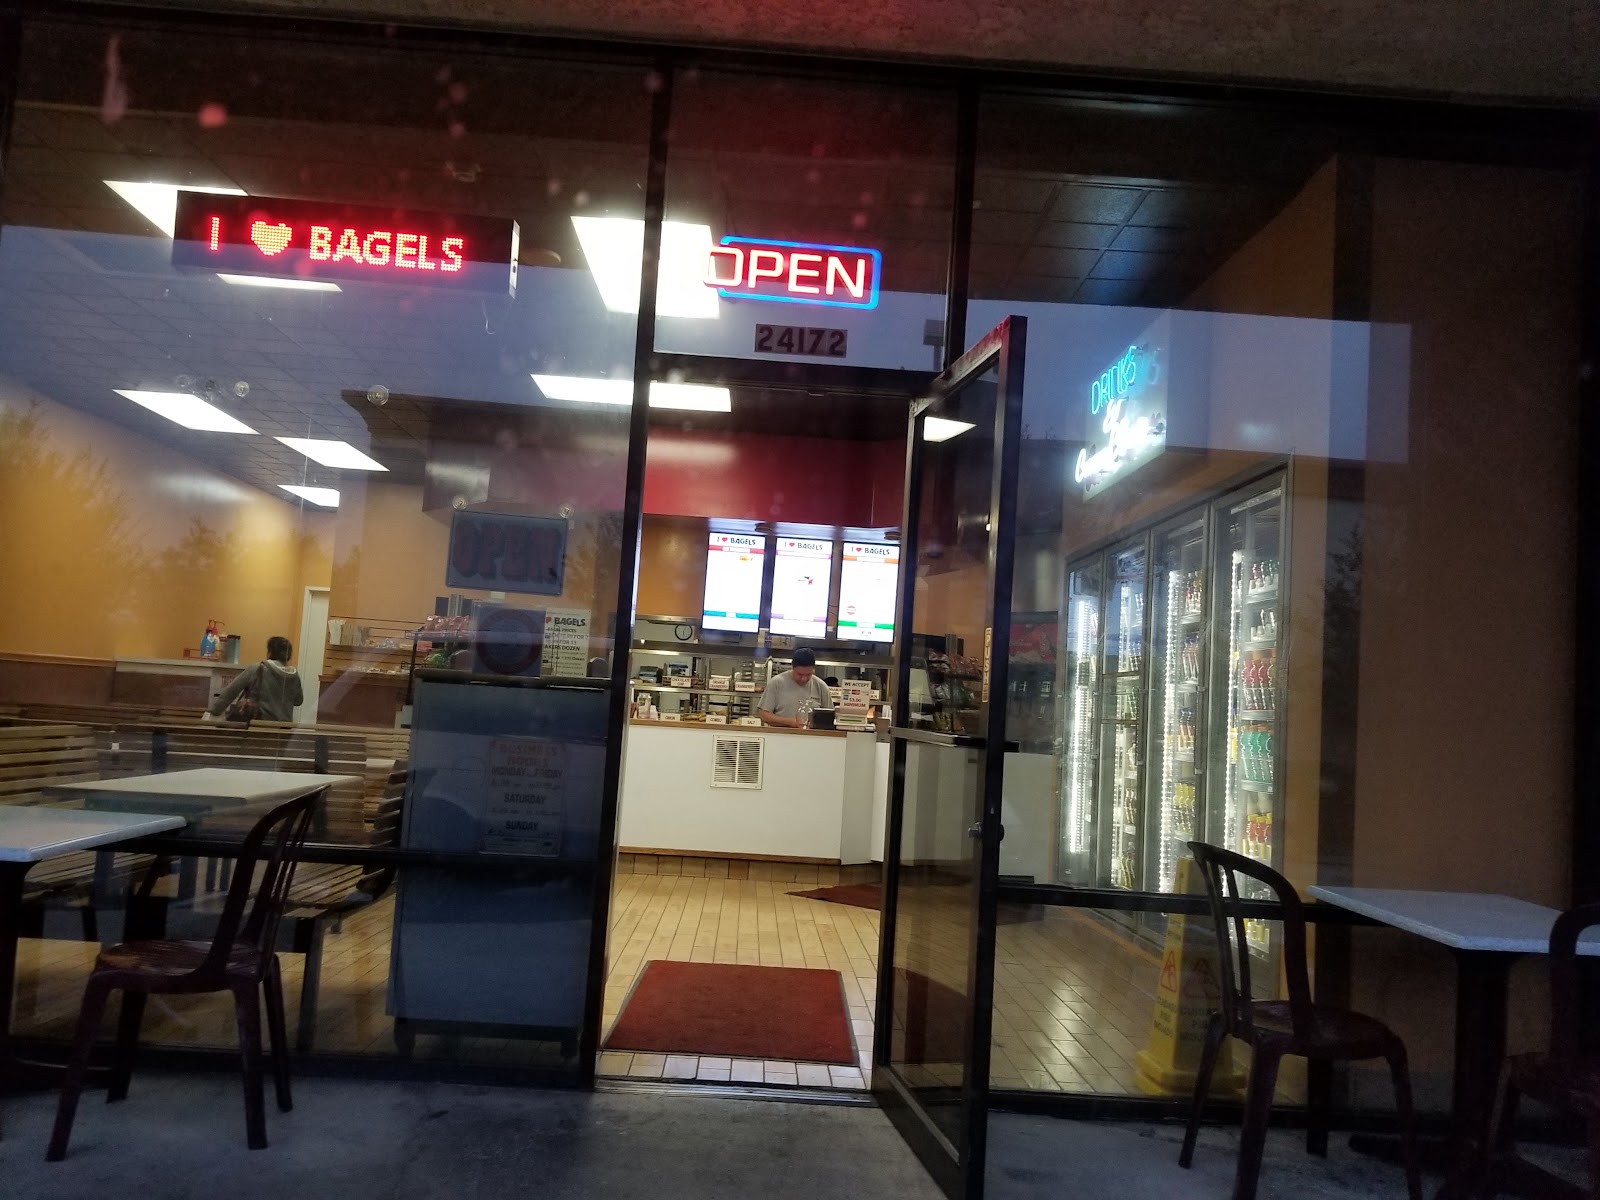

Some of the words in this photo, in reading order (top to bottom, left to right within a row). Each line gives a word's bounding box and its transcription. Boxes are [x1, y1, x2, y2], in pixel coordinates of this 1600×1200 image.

[209, 216, 220, 252] I
[309, 225, 464, 273] BAGELS
[703, 246, 866, 298] OPEN
[758, 326, 844, 356] 24172
[730, 537, 756, 545] BAGELS
[797, 542, 823, 551] BAGELS
[454, 521, 562, 584] OPEN
[864, 547, 890, 556] BAGELS
[554, 617, 586, 627] BAGELS
[491, 765, 526, 776] MONDAY
[535, 767, 563, 779] FRIDAY
[503, 792, 547, 805] SATURDAY
[505, 819, 540, 832] SUNDAY
